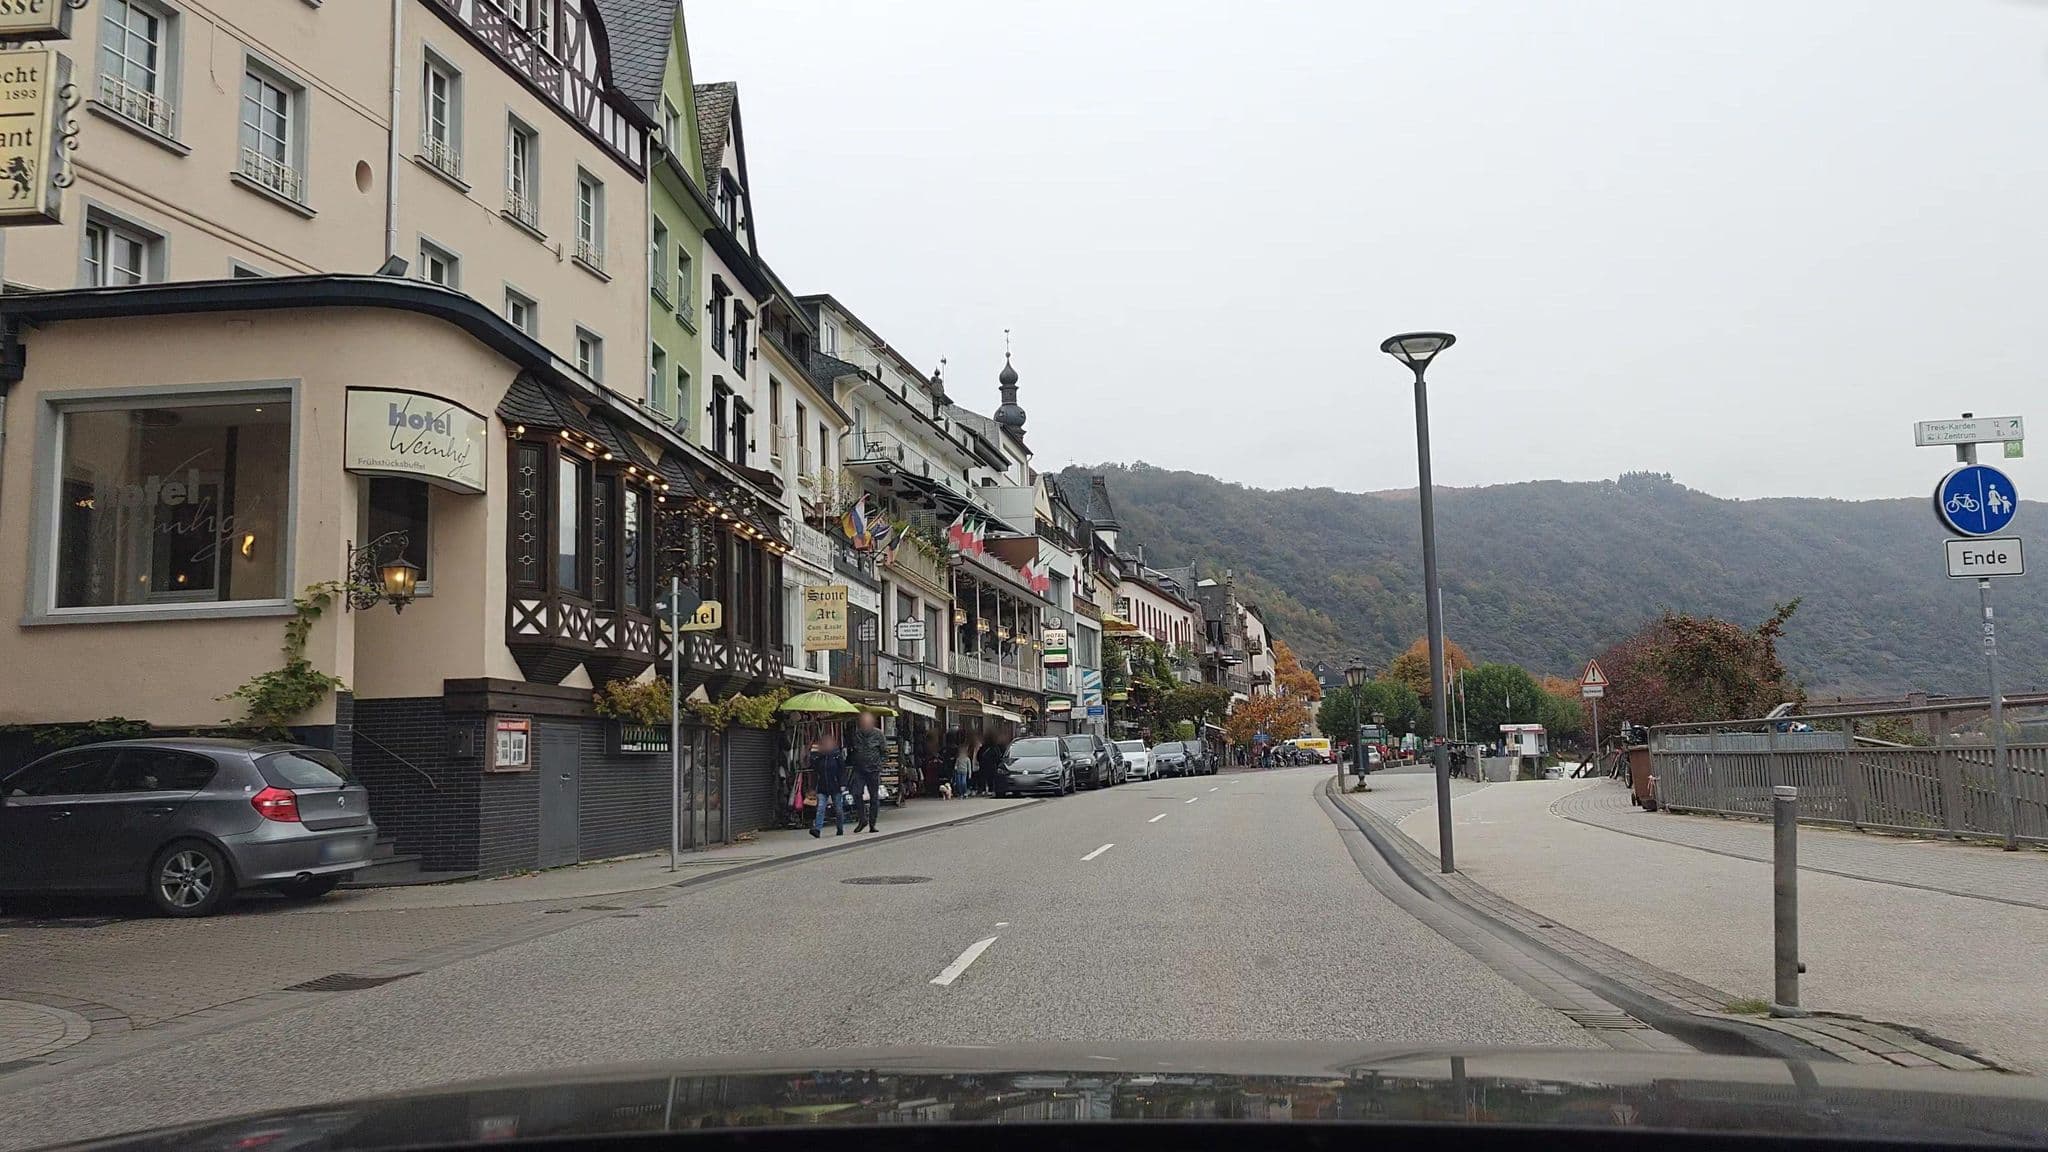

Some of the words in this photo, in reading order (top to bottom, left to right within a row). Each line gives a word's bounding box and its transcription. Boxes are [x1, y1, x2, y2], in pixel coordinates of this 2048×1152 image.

[0, 67, 37, 83] cht
[6, 89, 37, 100] 1893
[388, 402, 451, 436] hotel
[1926, 423, 1976, 432] Treis-Karden
[390, 396, 471, 477] Weinhof
[1944, 432, 1976, 440] Zentrum
[1962, 550, 2007, 566] Ende
[808, 590, 845, 601] Stone
[816, 608, 836, 620] Art
